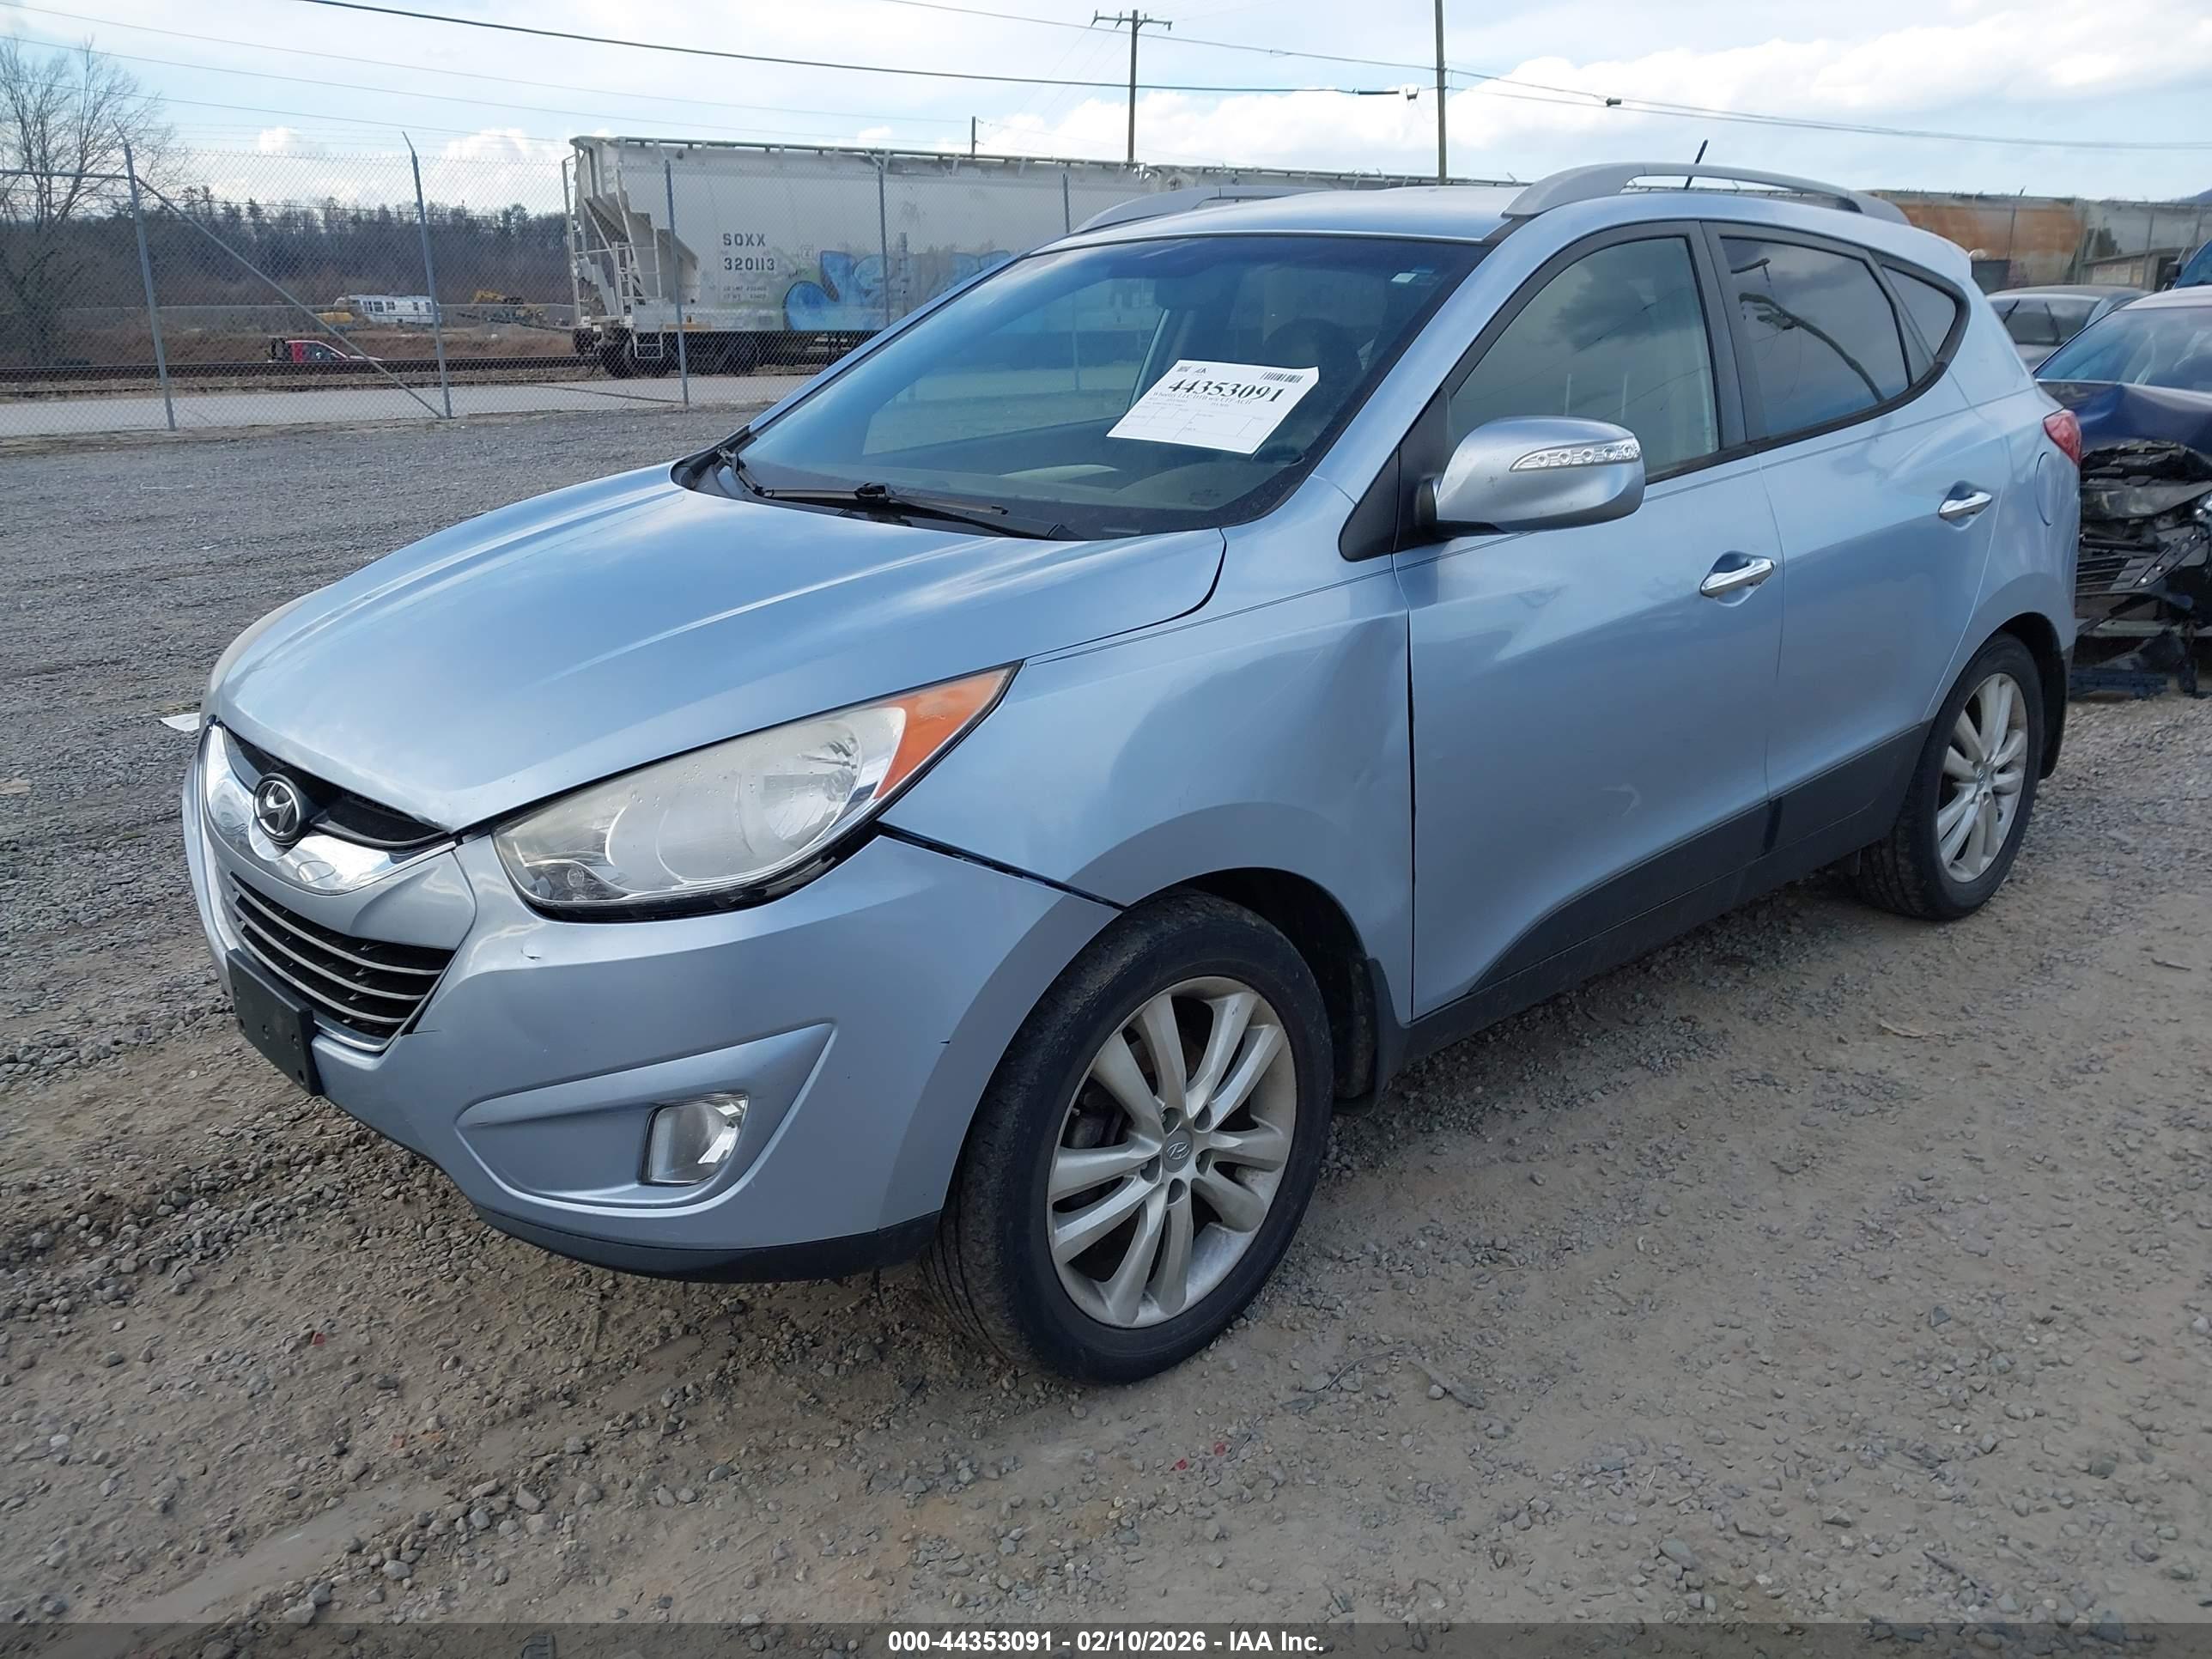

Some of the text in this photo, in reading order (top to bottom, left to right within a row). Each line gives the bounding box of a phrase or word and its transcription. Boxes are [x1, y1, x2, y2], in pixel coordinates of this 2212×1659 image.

[723, 233, 766, 246] SOXX
[724, 258, 775, 271] 320113
[1169, 378, 1285, 403] 44353091
